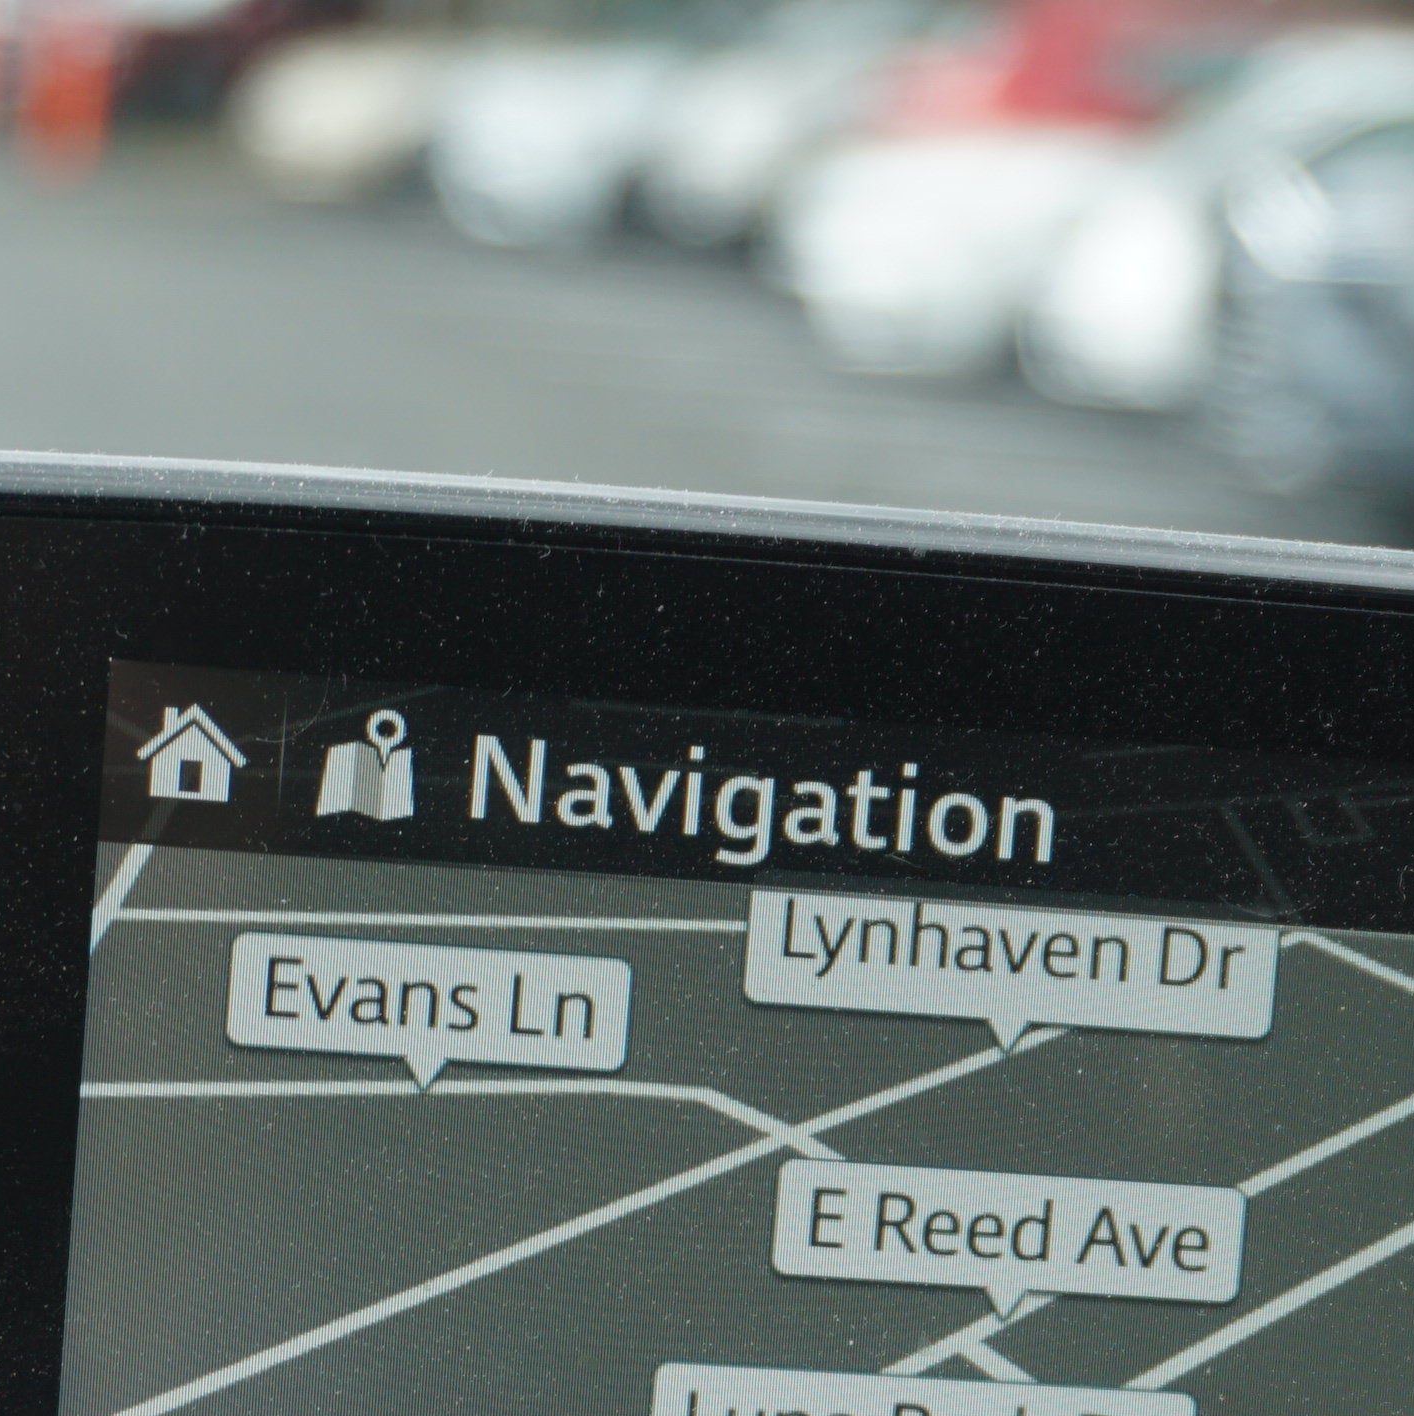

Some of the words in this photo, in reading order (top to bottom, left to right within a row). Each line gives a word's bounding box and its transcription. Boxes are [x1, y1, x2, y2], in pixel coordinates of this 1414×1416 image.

[469, 733, 1057, 867] Navigation
[782, 896, 1130, 979] Lynhaven
[1158, 926, 1247, 991] Dr
[263, 956, 481, 1032] Evans
[508, 972, 596, 1041] Ln
[809, 1187, 848, 1250] E
[873, 1191, 1054, 1262] Reed
[1075, 1206, 1213, 1273] Ave
